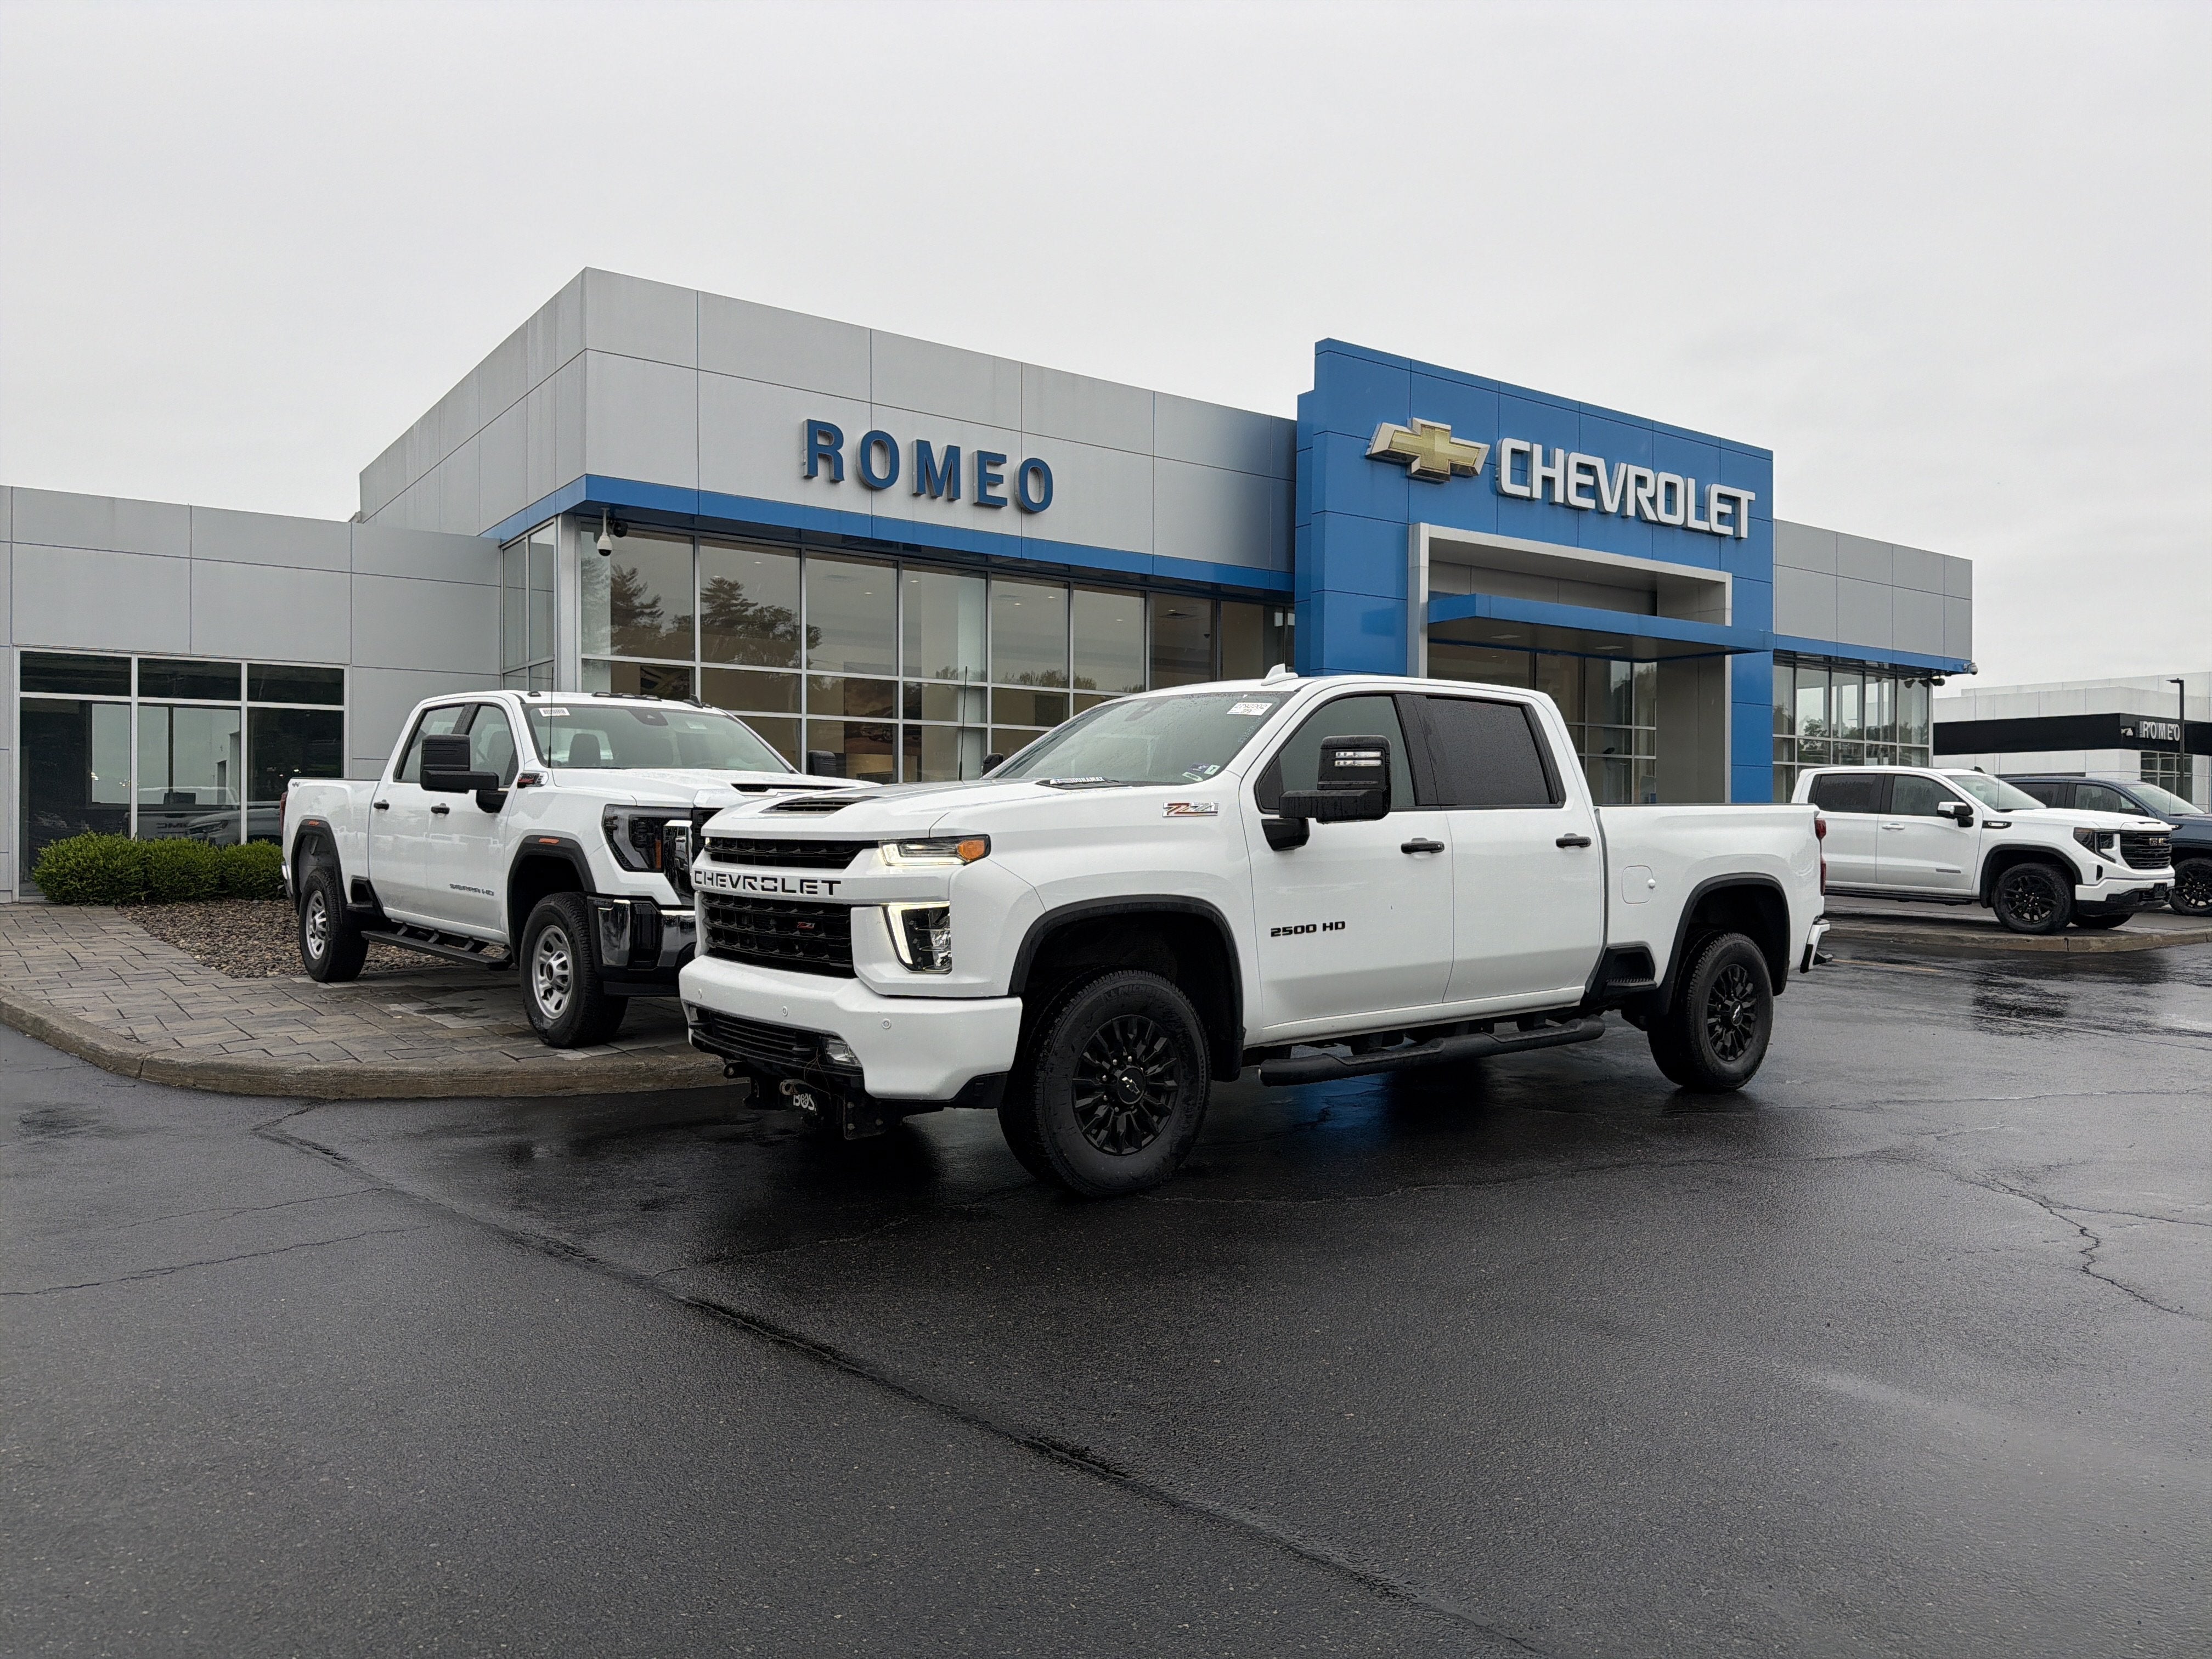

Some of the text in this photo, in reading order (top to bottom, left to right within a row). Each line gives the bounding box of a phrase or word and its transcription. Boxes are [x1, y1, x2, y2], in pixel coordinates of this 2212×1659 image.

[803, 419, 1053, 513] ROMEO
[1497, 437, 1756, 539] CHEVROLET
[2140, 721, 2180, 741] ROMEO
[1163, 802, 1220, 817] Z71
[449, 883, 481, 894] SIERRA
[694, 870, 842, 896] CHEVROLET
[1271, 921, 1346, 938] 2500 HD
